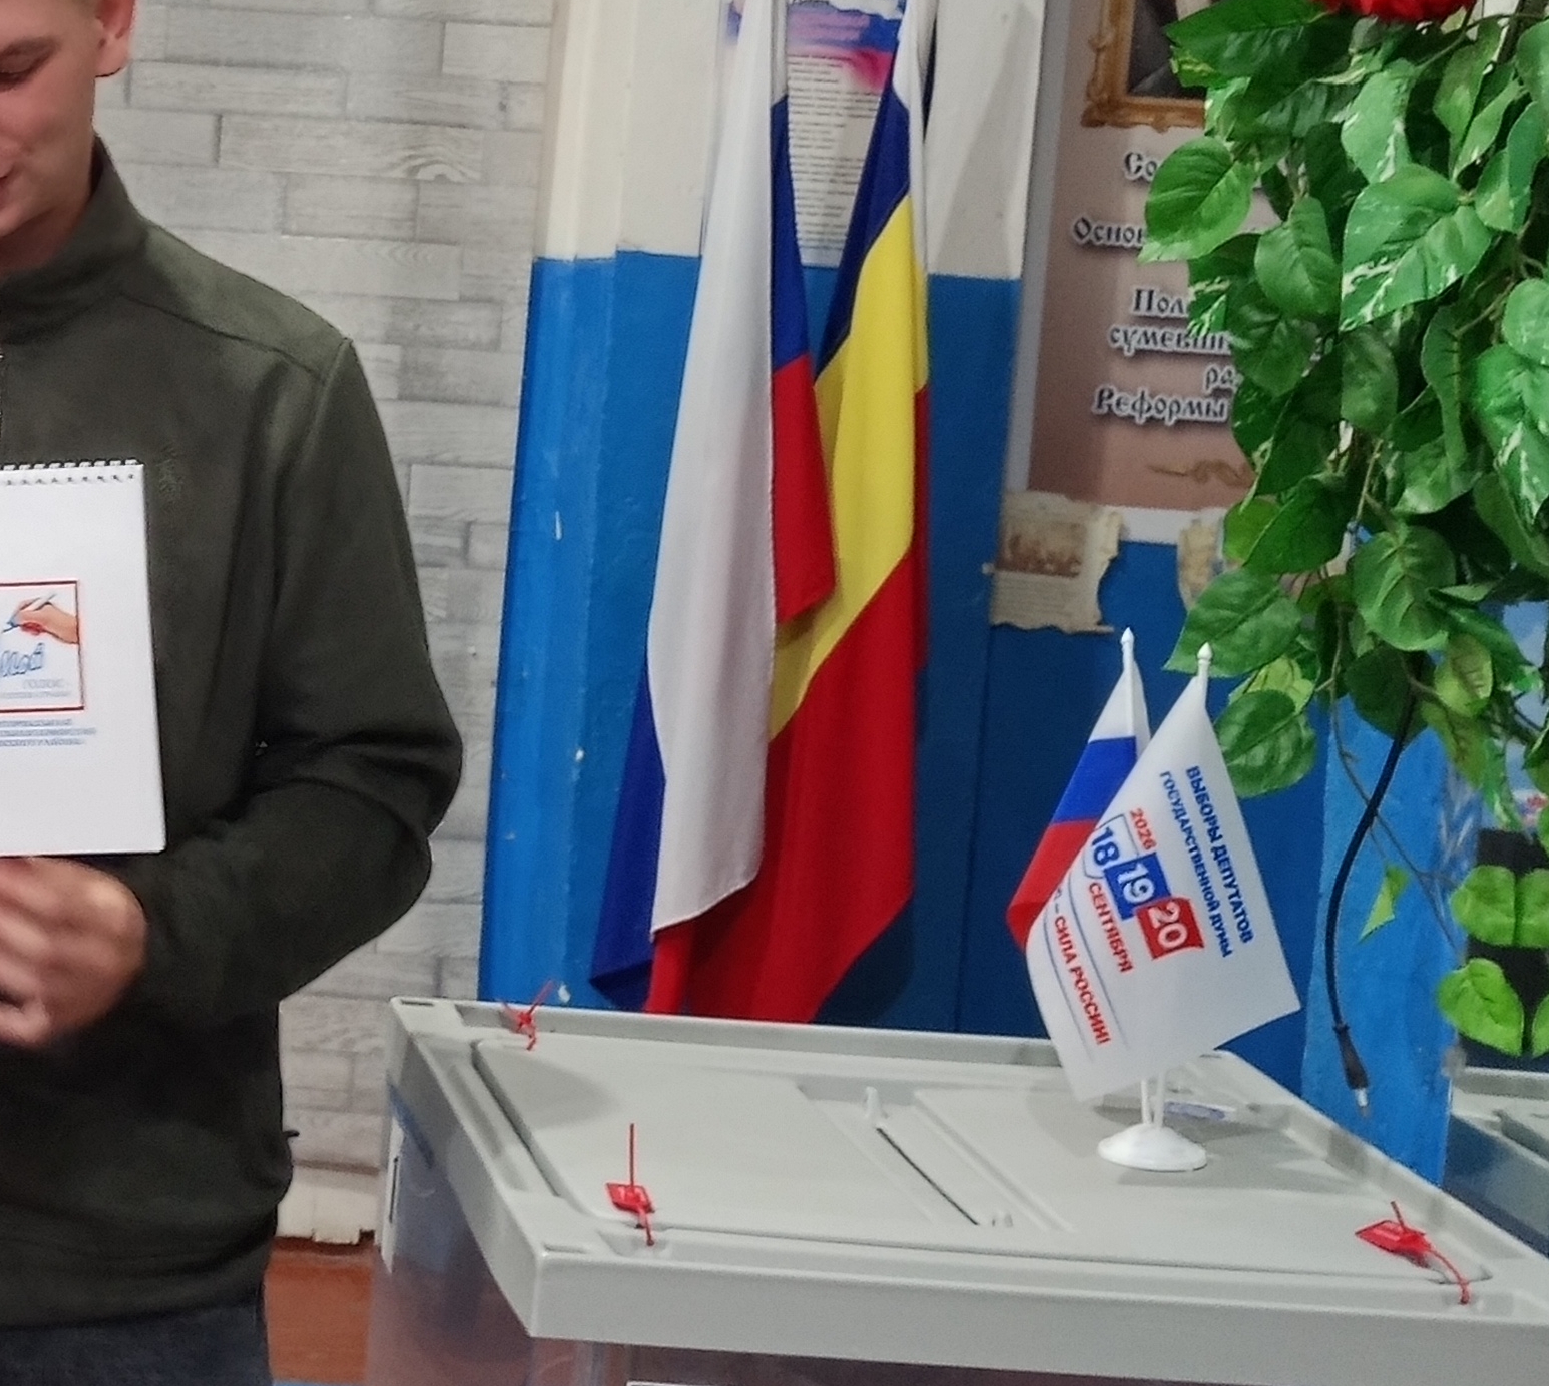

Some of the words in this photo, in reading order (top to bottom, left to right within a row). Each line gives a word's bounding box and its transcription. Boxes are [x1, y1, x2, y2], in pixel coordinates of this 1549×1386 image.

[1096, 387, 1226, 421] Реформы
[1091, 826, 1121, 869] 18
[1117, 862, 1155, 905] 19
[1148, 901, 1188, 949] 20
[1129, 807, 1157, 850] 2026
[1160, 770, 1221, 913] ГОСУДАРСТВЕННОЙ
[1209, 912, 1234, 958] ДУМЫ
[1186, 765, 1224, 843] ВЫБОРЫ
[1210, 844, 1255, 944] ДЕПУТАТОВ
[1054, 915, 1078, 965] СИЛА
[1070, 966, 1111, 1046] РОССИИ!
[1088, 881, 1133, 973] СЕНТЯБРЯ
